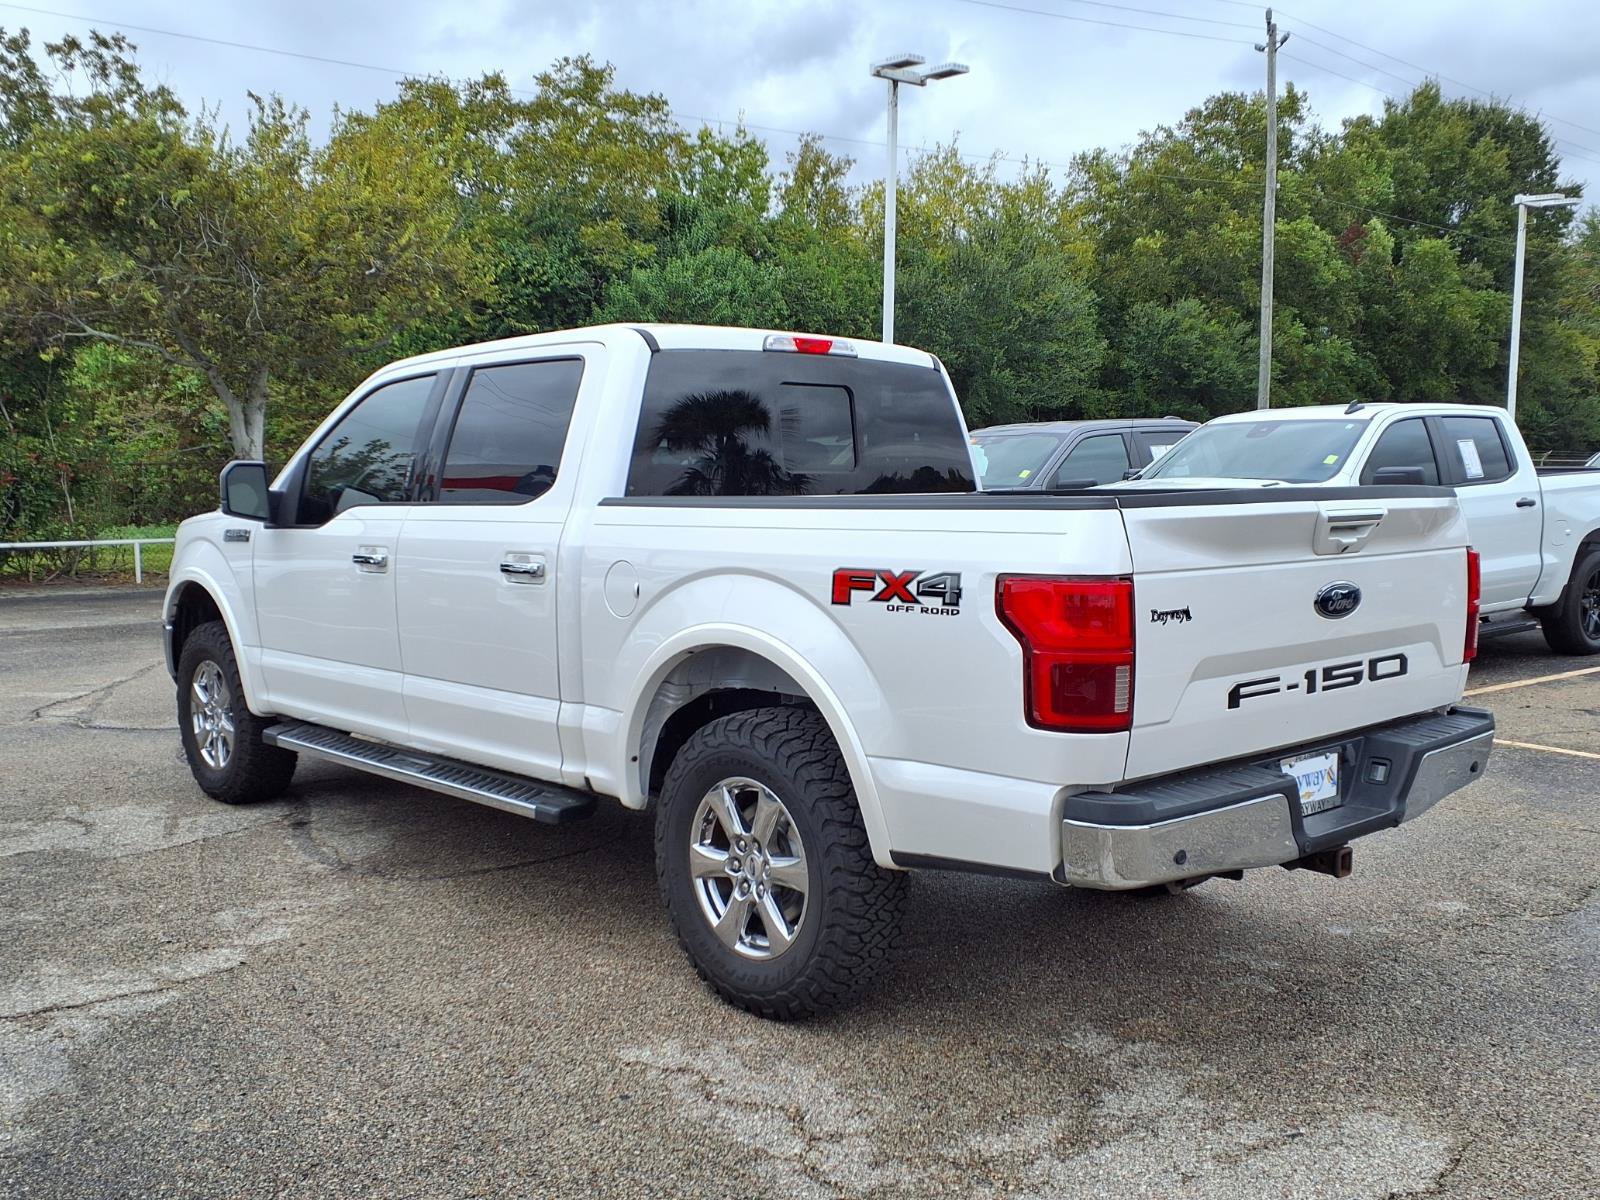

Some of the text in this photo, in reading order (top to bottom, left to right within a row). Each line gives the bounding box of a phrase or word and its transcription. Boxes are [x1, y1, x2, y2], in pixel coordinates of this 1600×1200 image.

[831, 567, 963, 607] FX4
[886, 604, 960, 617] OFF ROAD
[1328, 589, 1355, 611] Ford
[1227, 652, 1408, 710] F-150
[1296, 768, 1327, 792] yway
[1301, 799, 1326, 816] AYWAY
